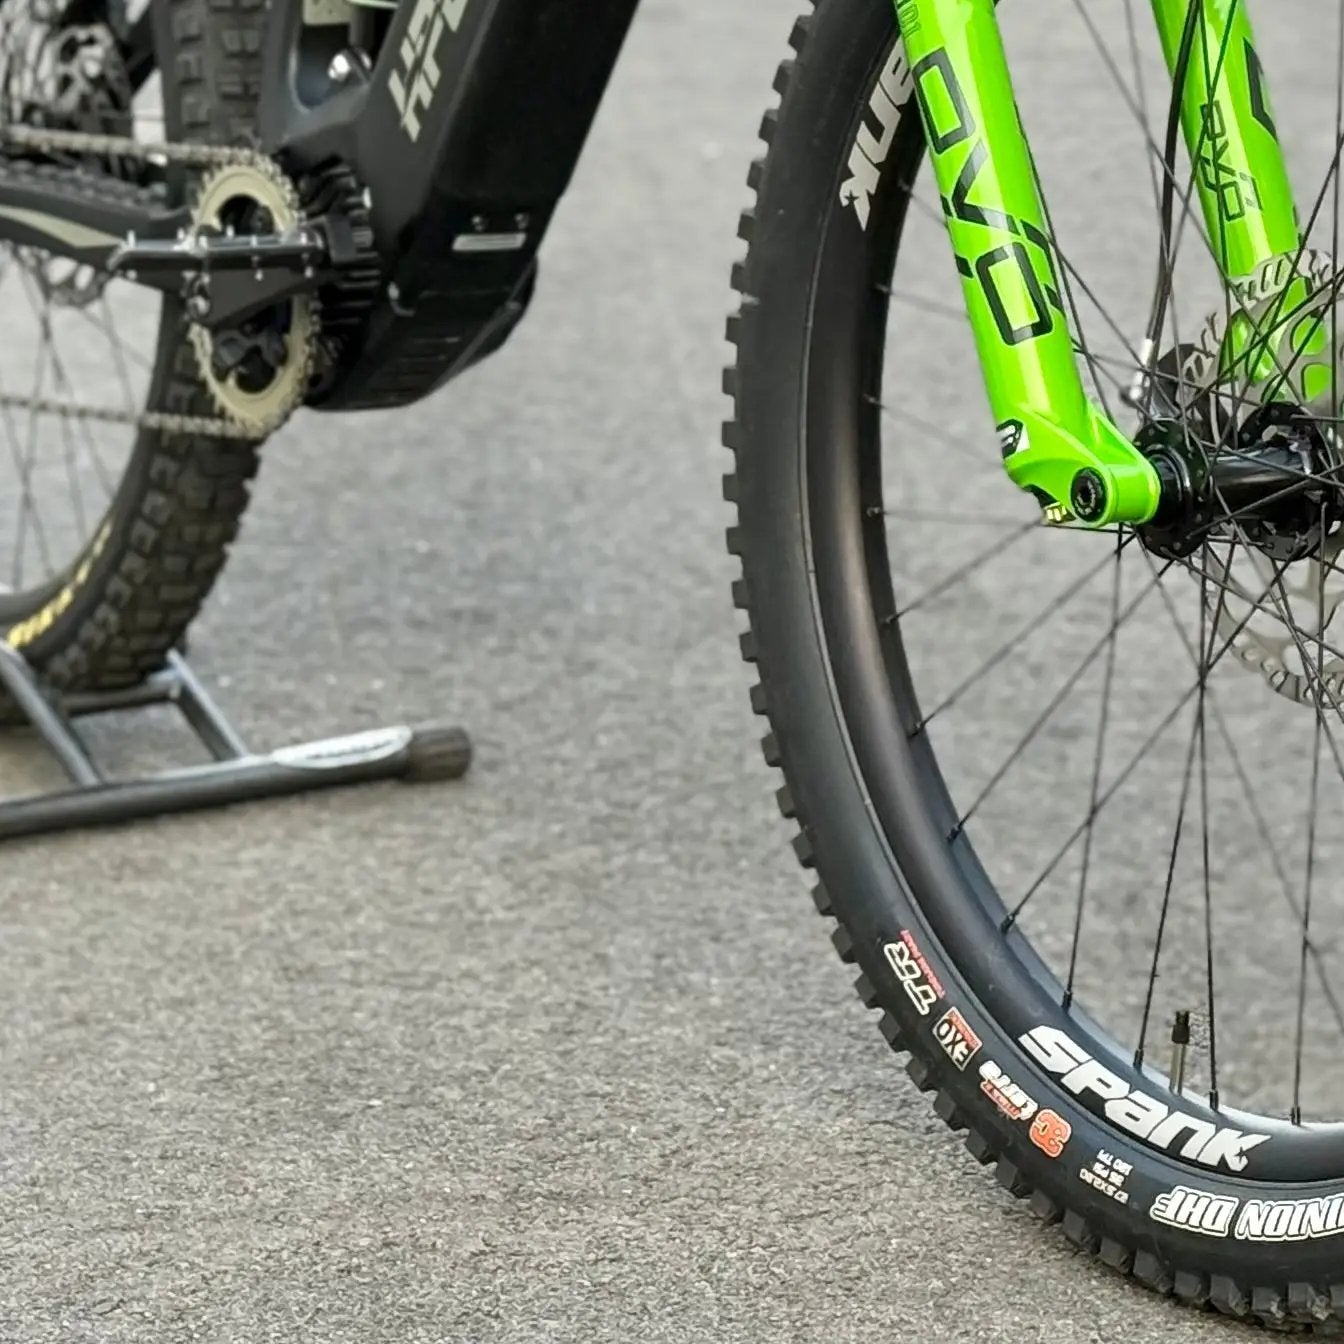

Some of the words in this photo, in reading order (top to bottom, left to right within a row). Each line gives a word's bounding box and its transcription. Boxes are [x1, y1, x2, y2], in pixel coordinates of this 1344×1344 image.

[911, 46, 1055, 347] DVO
[882, 940, 938, 1016] TR
[935, 1017, 976, 1068] EXO
[1028, 1108, 1072, 1158] 3C
[1149, 1184, 1239, 1238] DHF
